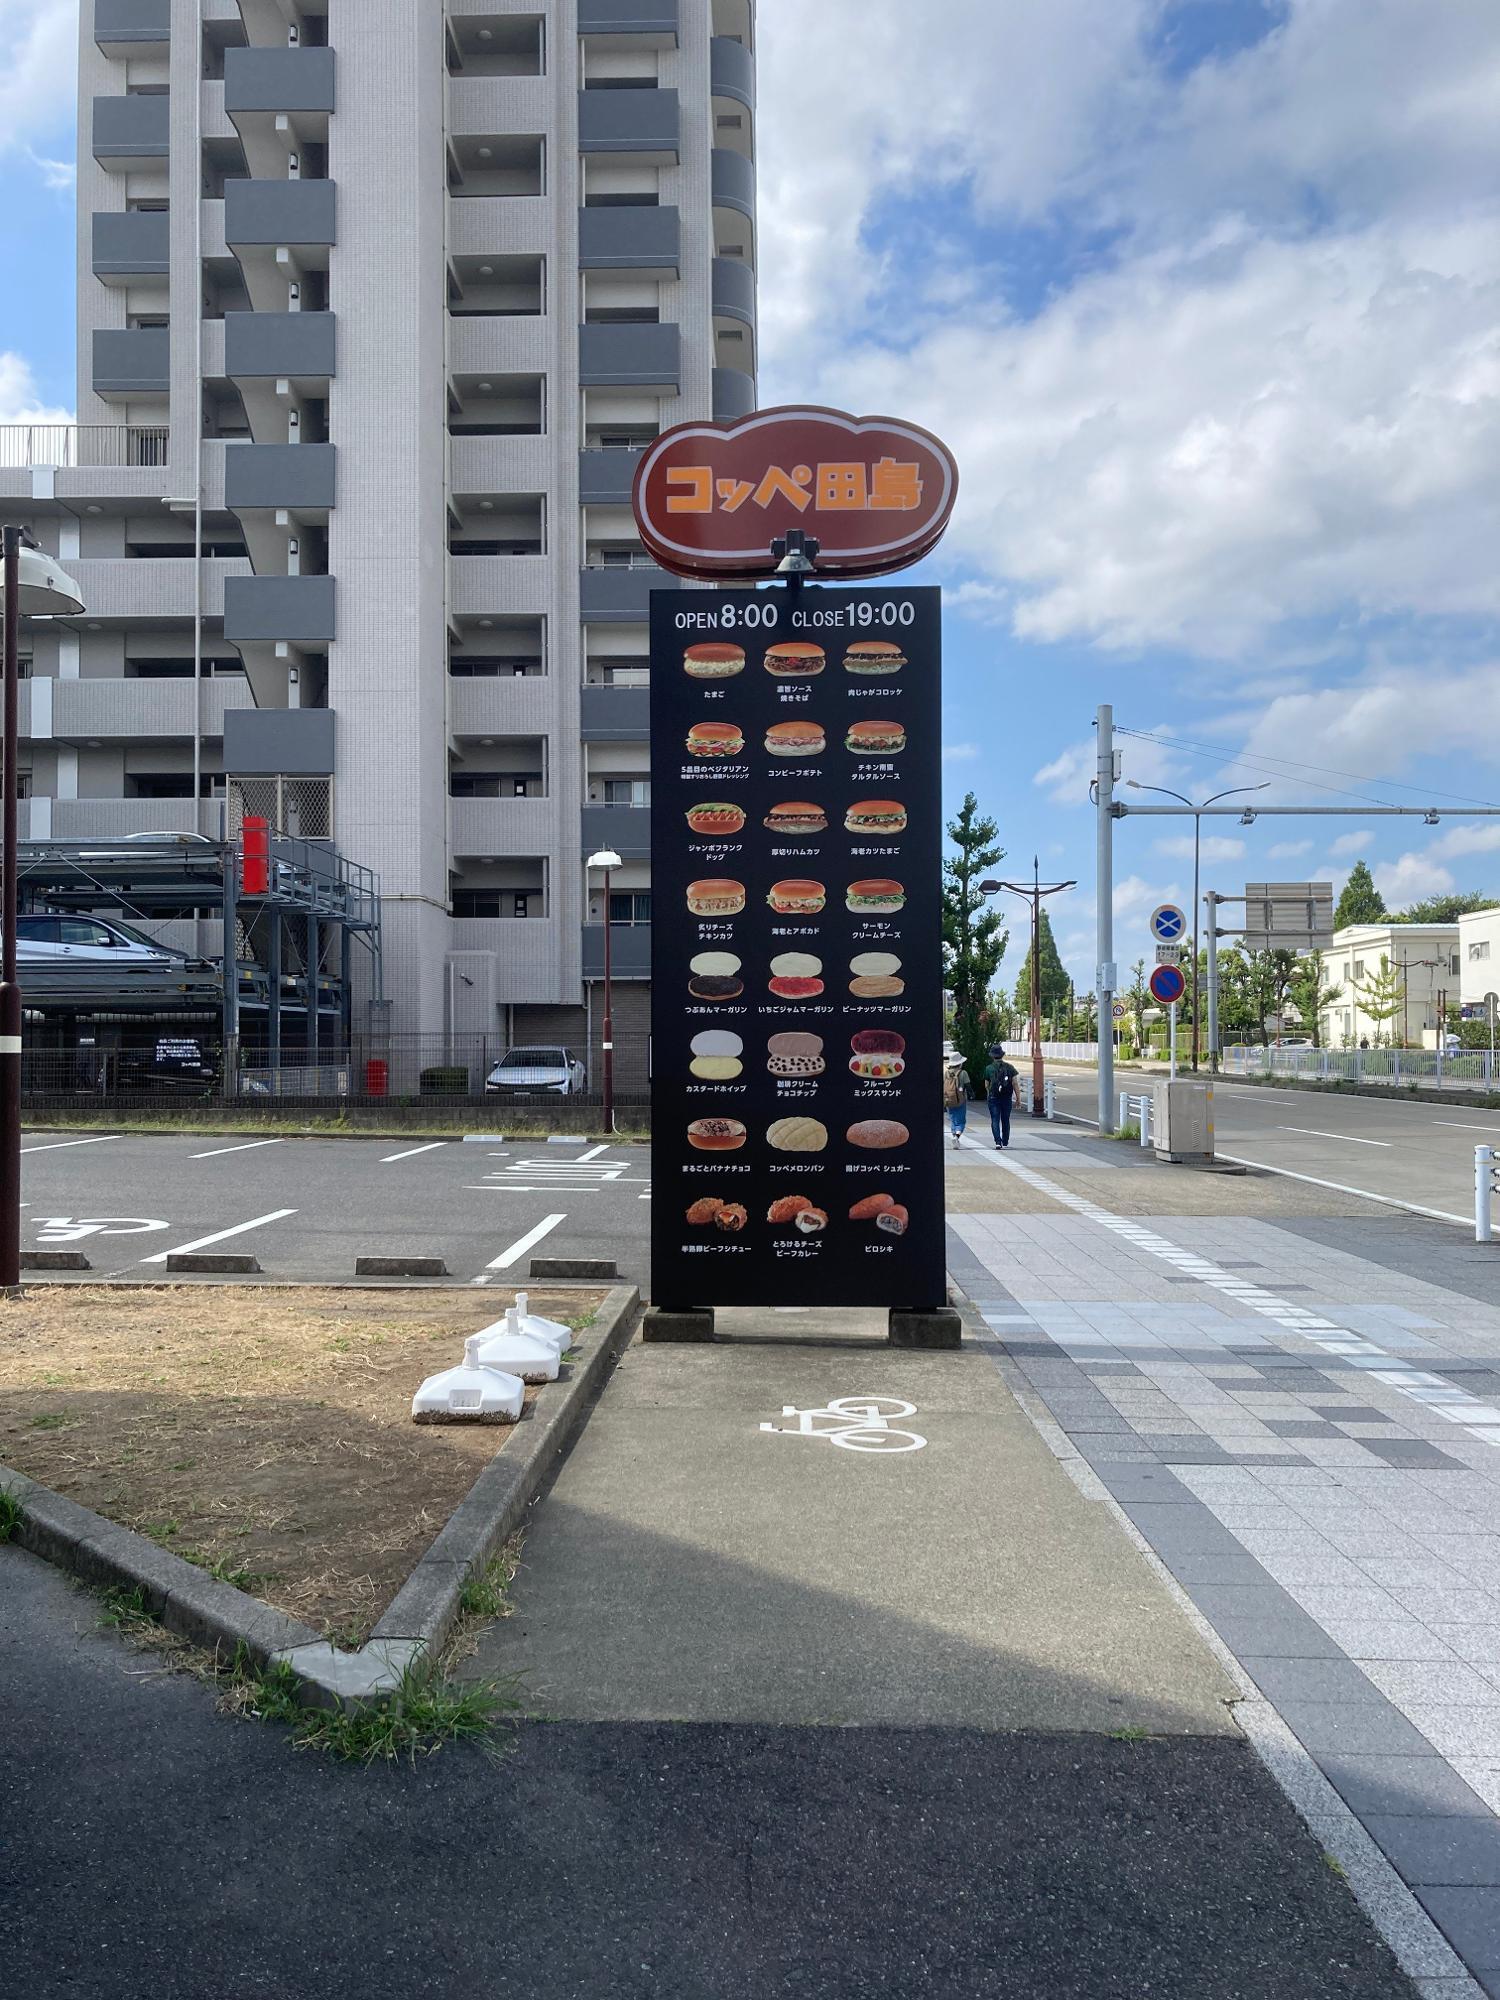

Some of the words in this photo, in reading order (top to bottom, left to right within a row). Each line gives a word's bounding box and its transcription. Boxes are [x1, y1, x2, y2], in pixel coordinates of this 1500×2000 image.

[666, 457, 924, 514] コッペ田島
[675, 613, 717, 629] OPEN
[720, 603, 777, 629] 8:00
[792, 611, 844, 627] CLOSE
[844, 601, 915, 627] 19:00
[781, 694, 809, 702] 焼きそば
[852, 931, 901, 939] クリームチーズ
